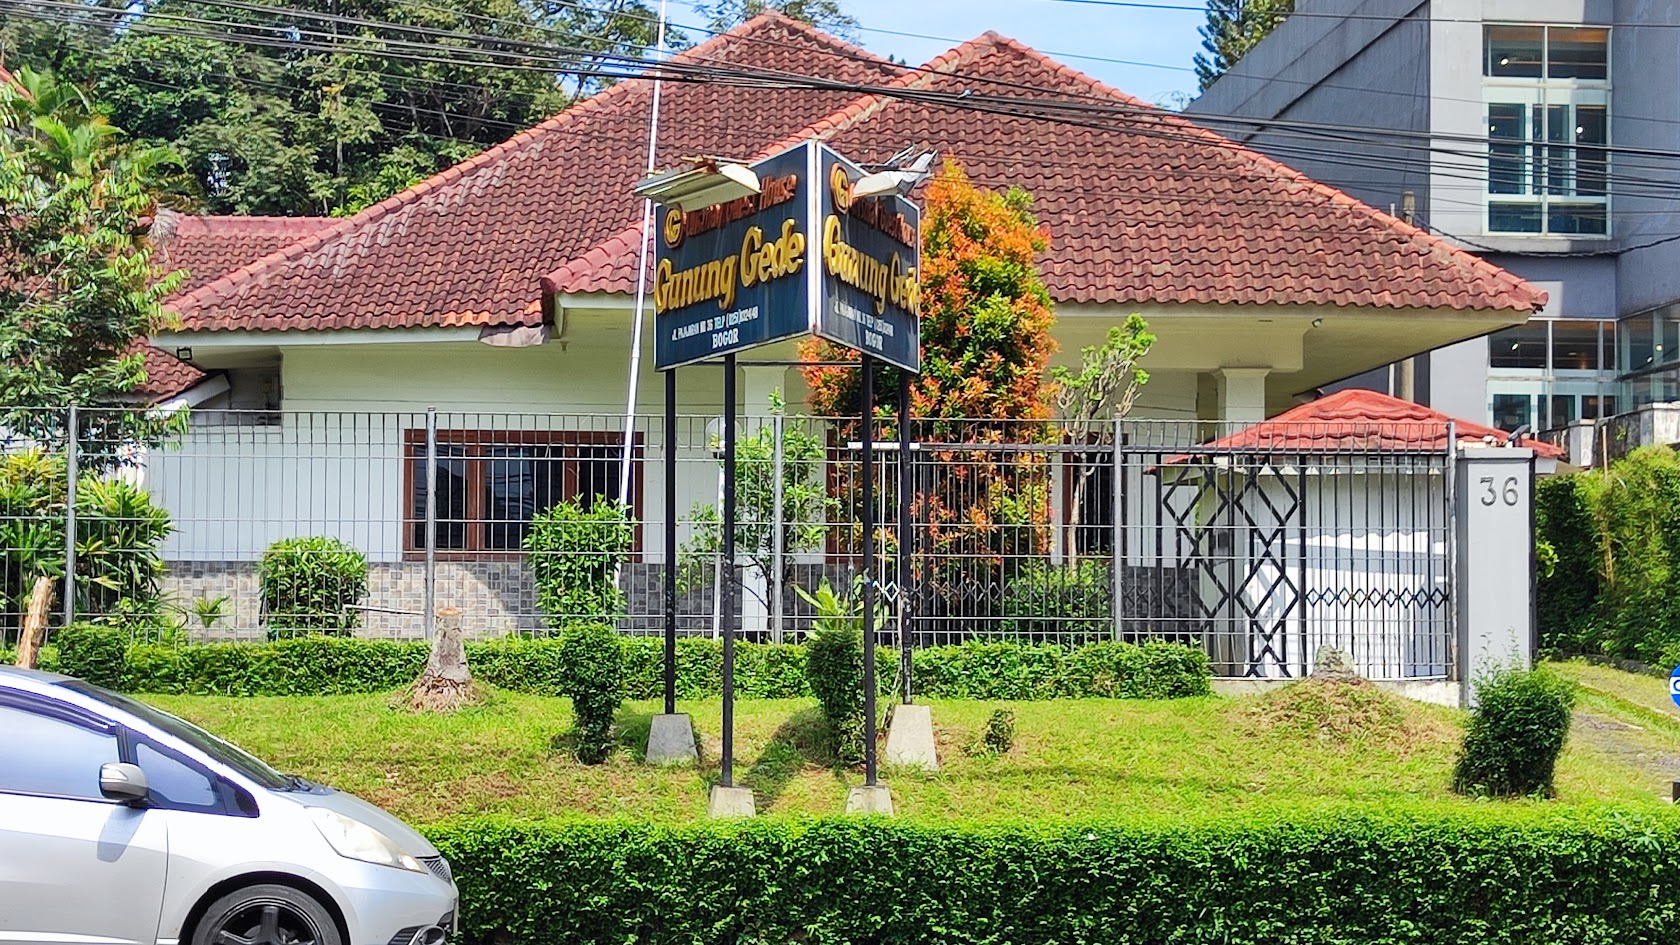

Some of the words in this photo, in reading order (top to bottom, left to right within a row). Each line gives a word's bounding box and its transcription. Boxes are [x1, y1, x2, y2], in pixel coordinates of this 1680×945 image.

[759, 174, 797, 211] House
[654, 257, 739, 315] Gunung
[740, 218, 805, 288] Gede
[823, 214, 888, 315] Gunung
[890, 251, 921, 317] Gede
[712, 328, 739, 349] BOGOR
[1480, 476, 1519, 507] 36
